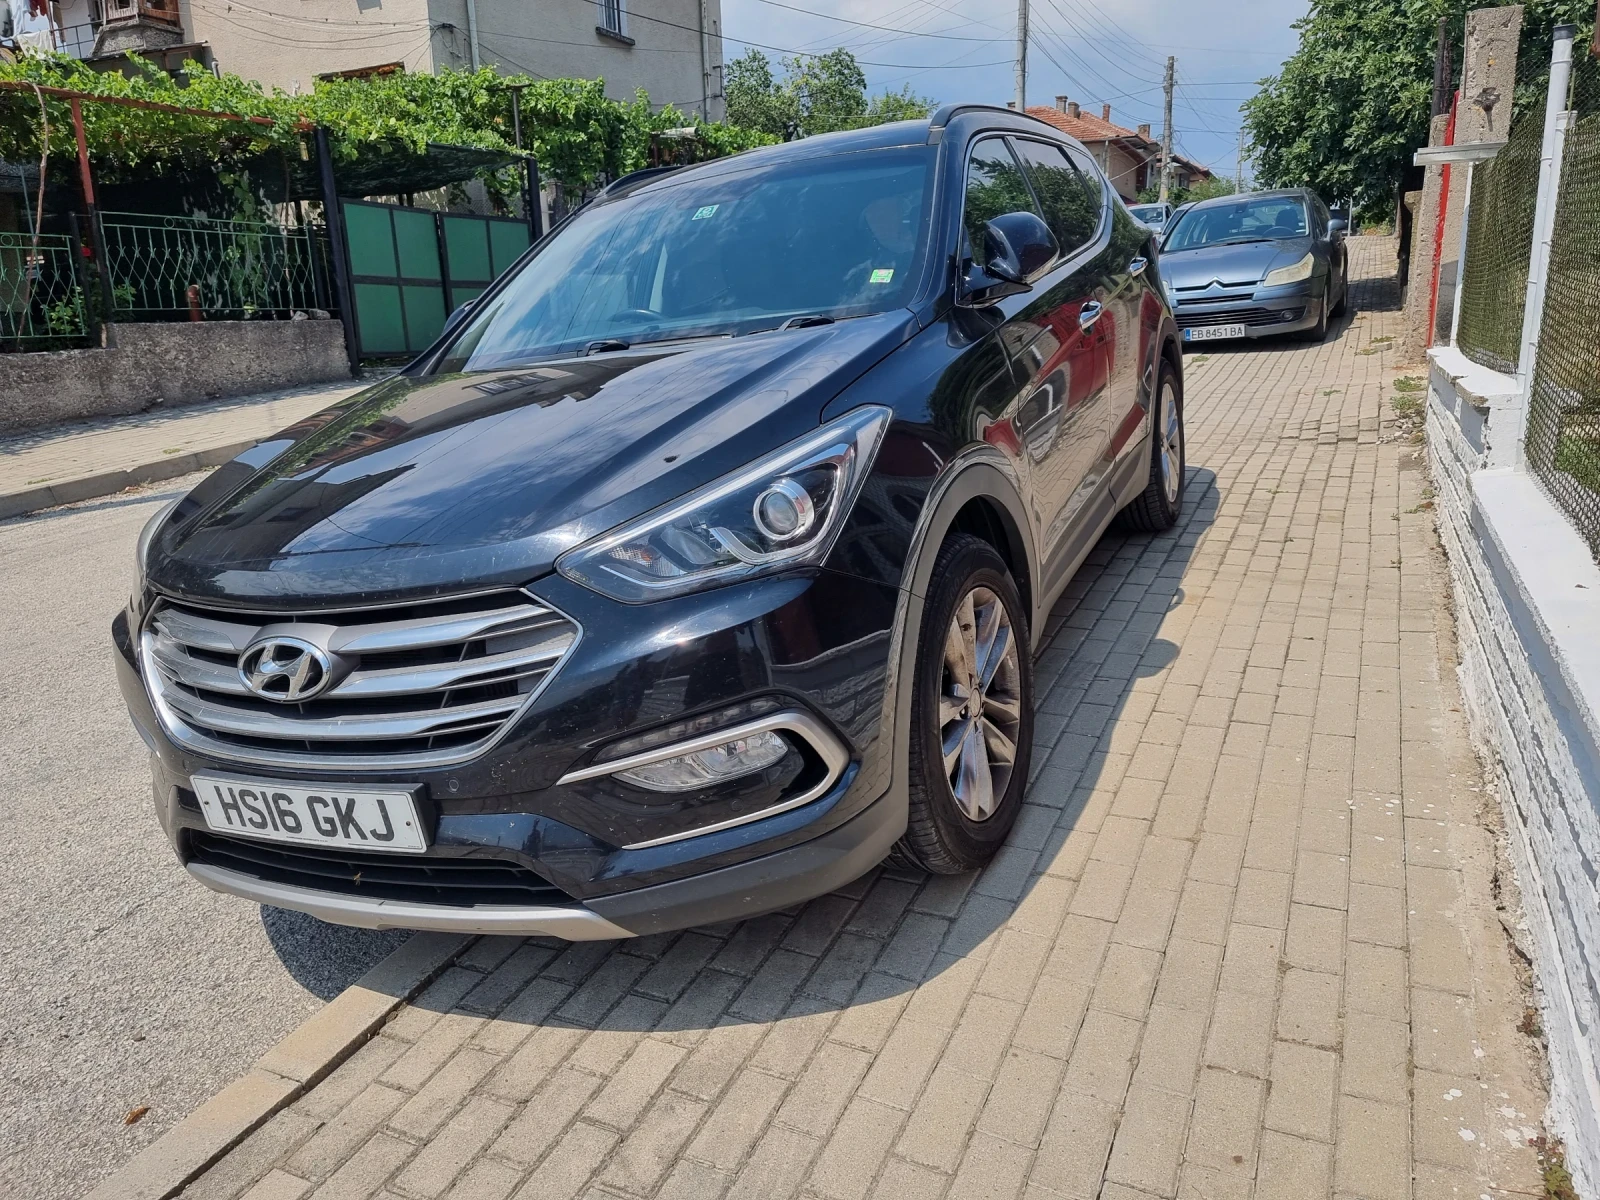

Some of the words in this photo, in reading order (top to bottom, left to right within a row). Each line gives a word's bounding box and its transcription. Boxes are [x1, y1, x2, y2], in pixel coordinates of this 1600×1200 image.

[1191, 329, 1204, 339] EB
[1205, 327, 1228, 338] 8451
[1230, 326, 1243, 337] BA
[213, 785, 303, 834] HS16
[306, 795, 395, 842] GKJ
